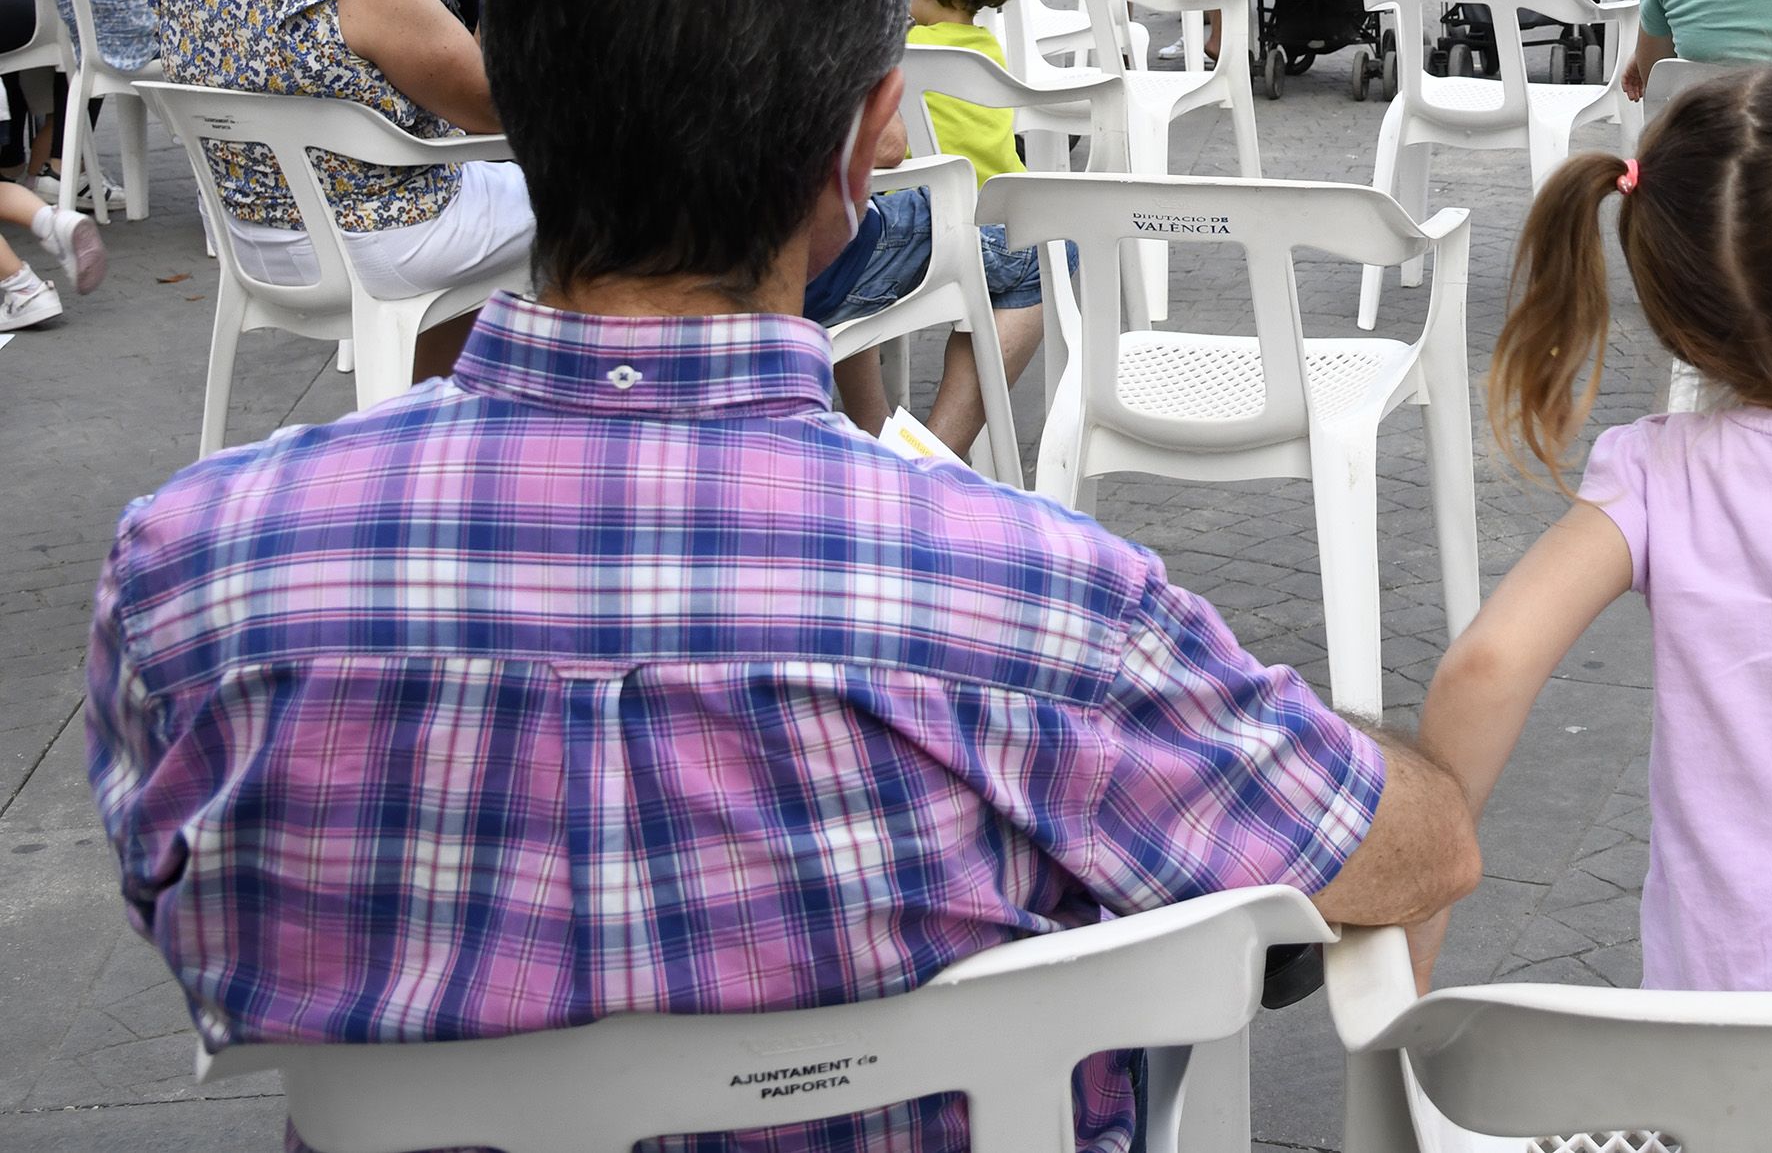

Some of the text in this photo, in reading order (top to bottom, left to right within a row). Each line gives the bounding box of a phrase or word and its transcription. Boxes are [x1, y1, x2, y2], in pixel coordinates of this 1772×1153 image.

[1133, 220, 1231, 234] VALÈNCIA
[730, 1054, 878, 1087] AJUNTAMENT de
[761, 1075, 851, 1099] PAIPORTA
